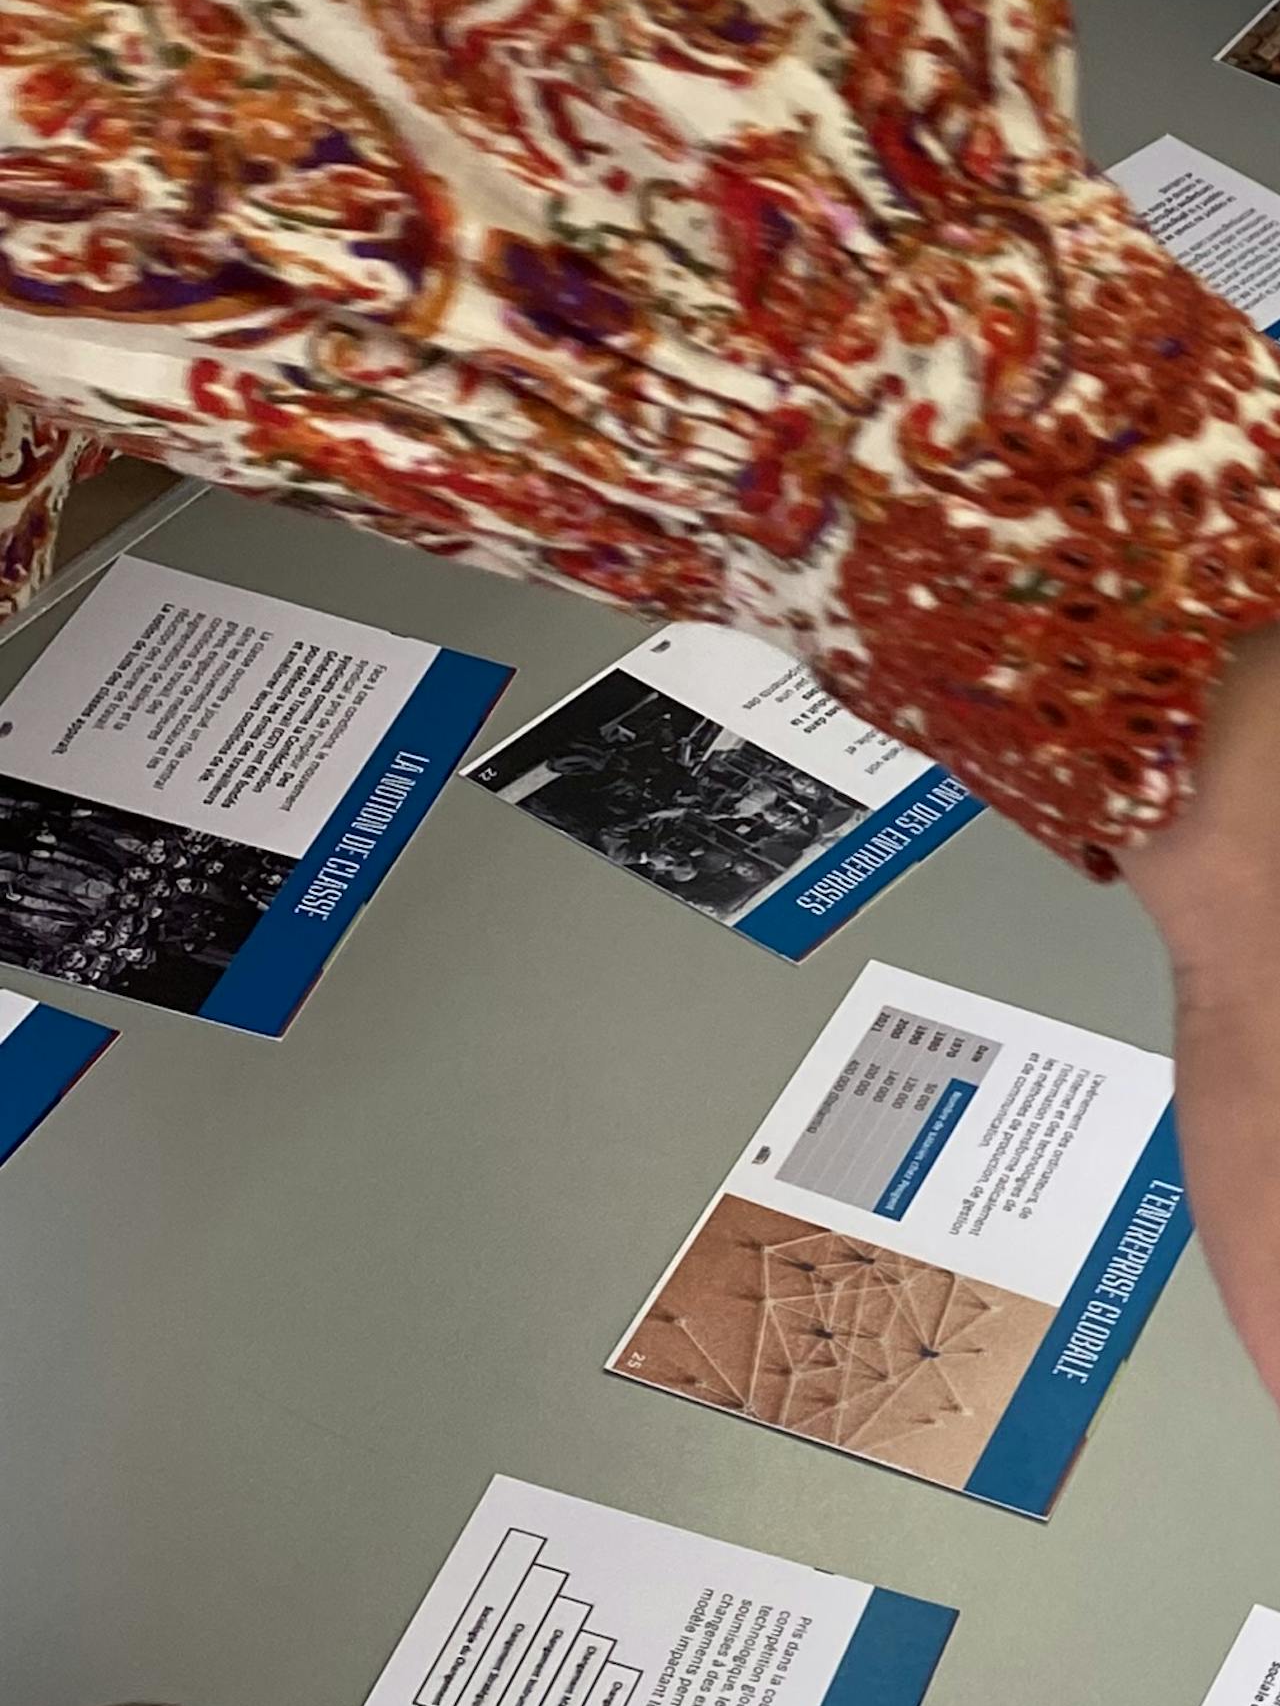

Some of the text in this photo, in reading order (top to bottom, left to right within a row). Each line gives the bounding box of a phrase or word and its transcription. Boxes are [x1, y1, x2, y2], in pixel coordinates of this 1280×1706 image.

[477, 766, 498, 781] 22
[893, 801, 943, 835] DES
[293, 750, 430, 921] LA NOTION DE CLASSE
[794, 825, 912, 916] ENTREPRISES
[1051, 1178, 1184, 1384] L'ENTREPRISE GLOBALE
[625, 1350, 646, 1369] 25
[790, 1615, 813, 1640] Pris
[747, 1609, 791, 1683] compétition
[775, 1640, 800, 1672] dans
[768, 1672, 786, 1686] la
